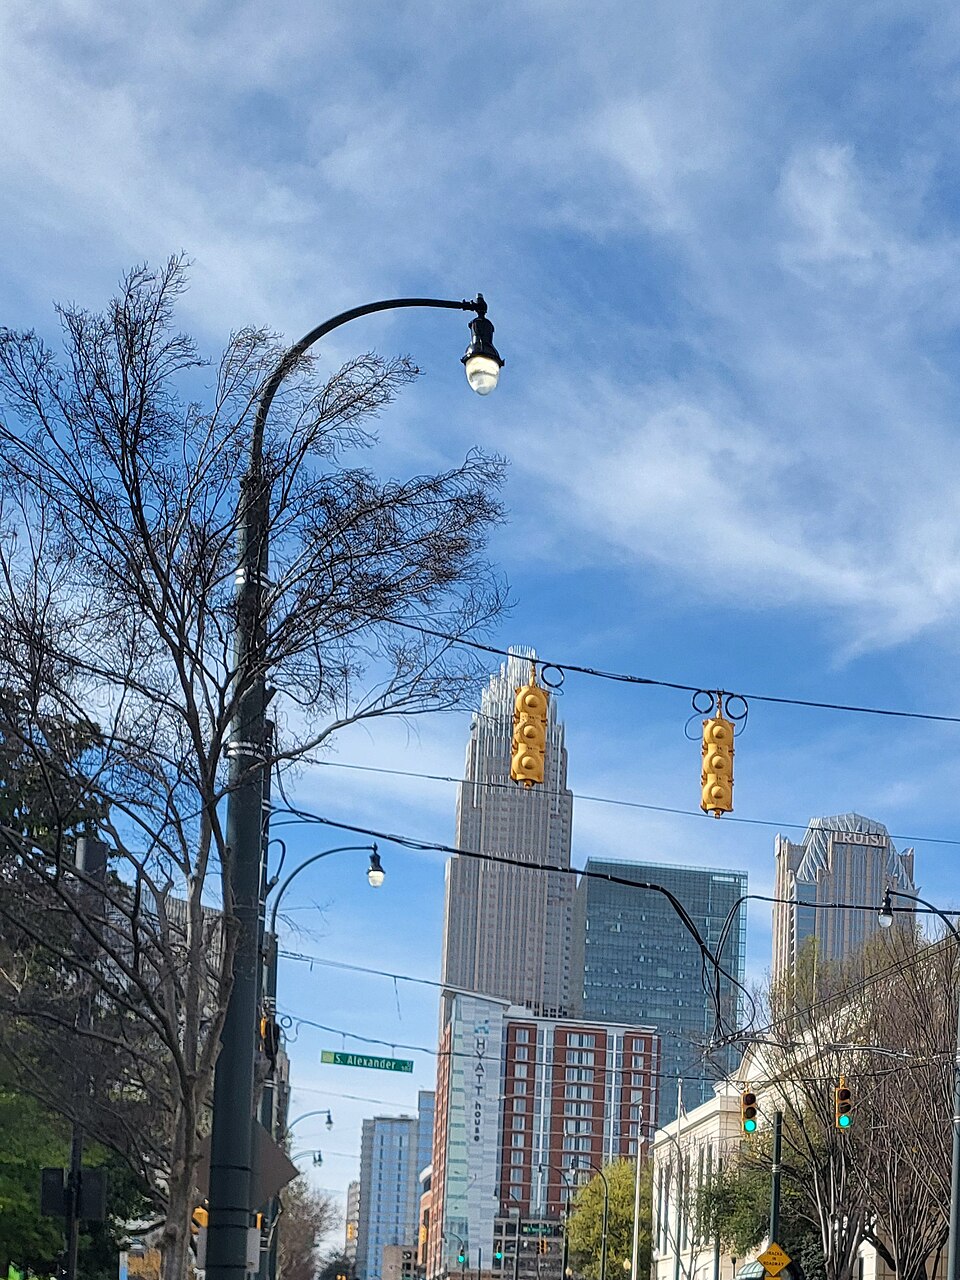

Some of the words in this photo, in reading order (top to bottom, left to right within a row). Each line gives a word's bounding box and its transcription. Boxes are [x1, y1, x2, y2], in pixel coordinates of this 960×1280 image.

[335, 1054, 343, 1064] S.
[346, 1055, 396, 1070] Alexander
[474, 1038, 485, 1096] HYATT
[474, 1101, 482, 1142] house
